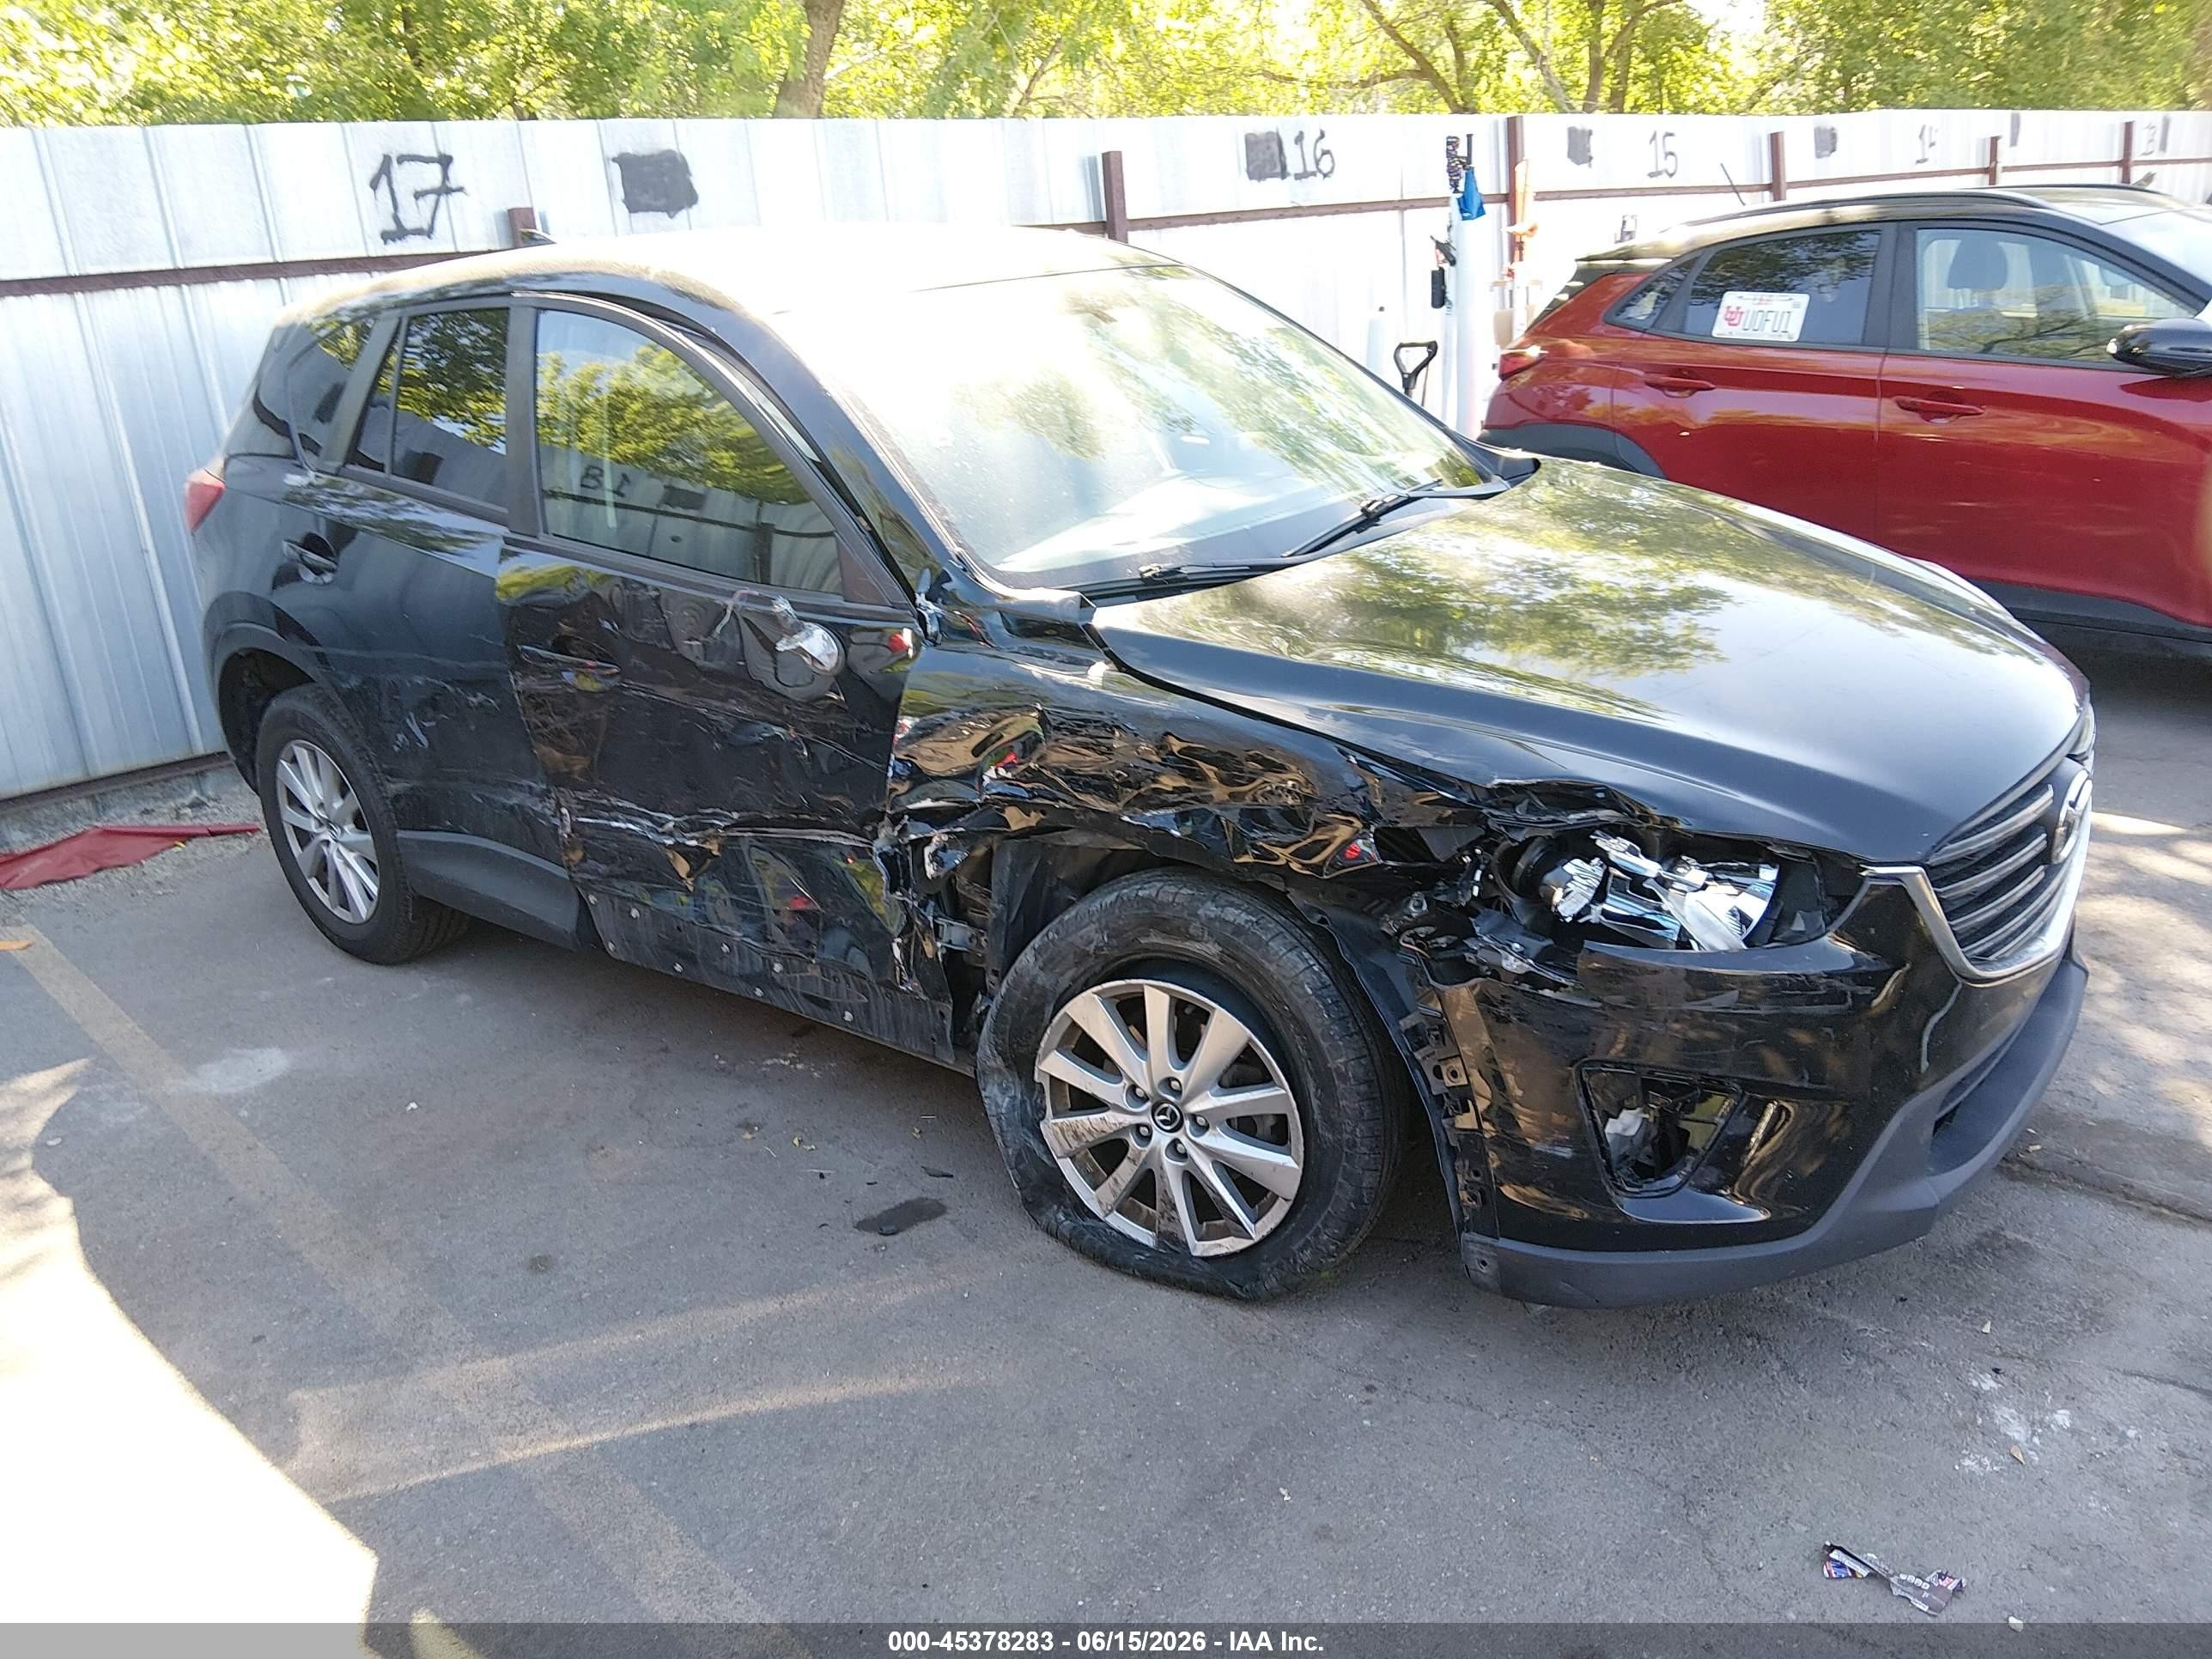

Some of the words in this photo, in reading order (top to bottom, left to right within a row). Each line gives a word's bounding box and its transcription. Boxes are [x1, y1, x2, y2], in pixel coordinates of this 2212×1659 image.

[1293, 129, 1335, 180] 16
[1647, 130, 1679, 179] 15
[369, 154, 466, 244] 17
